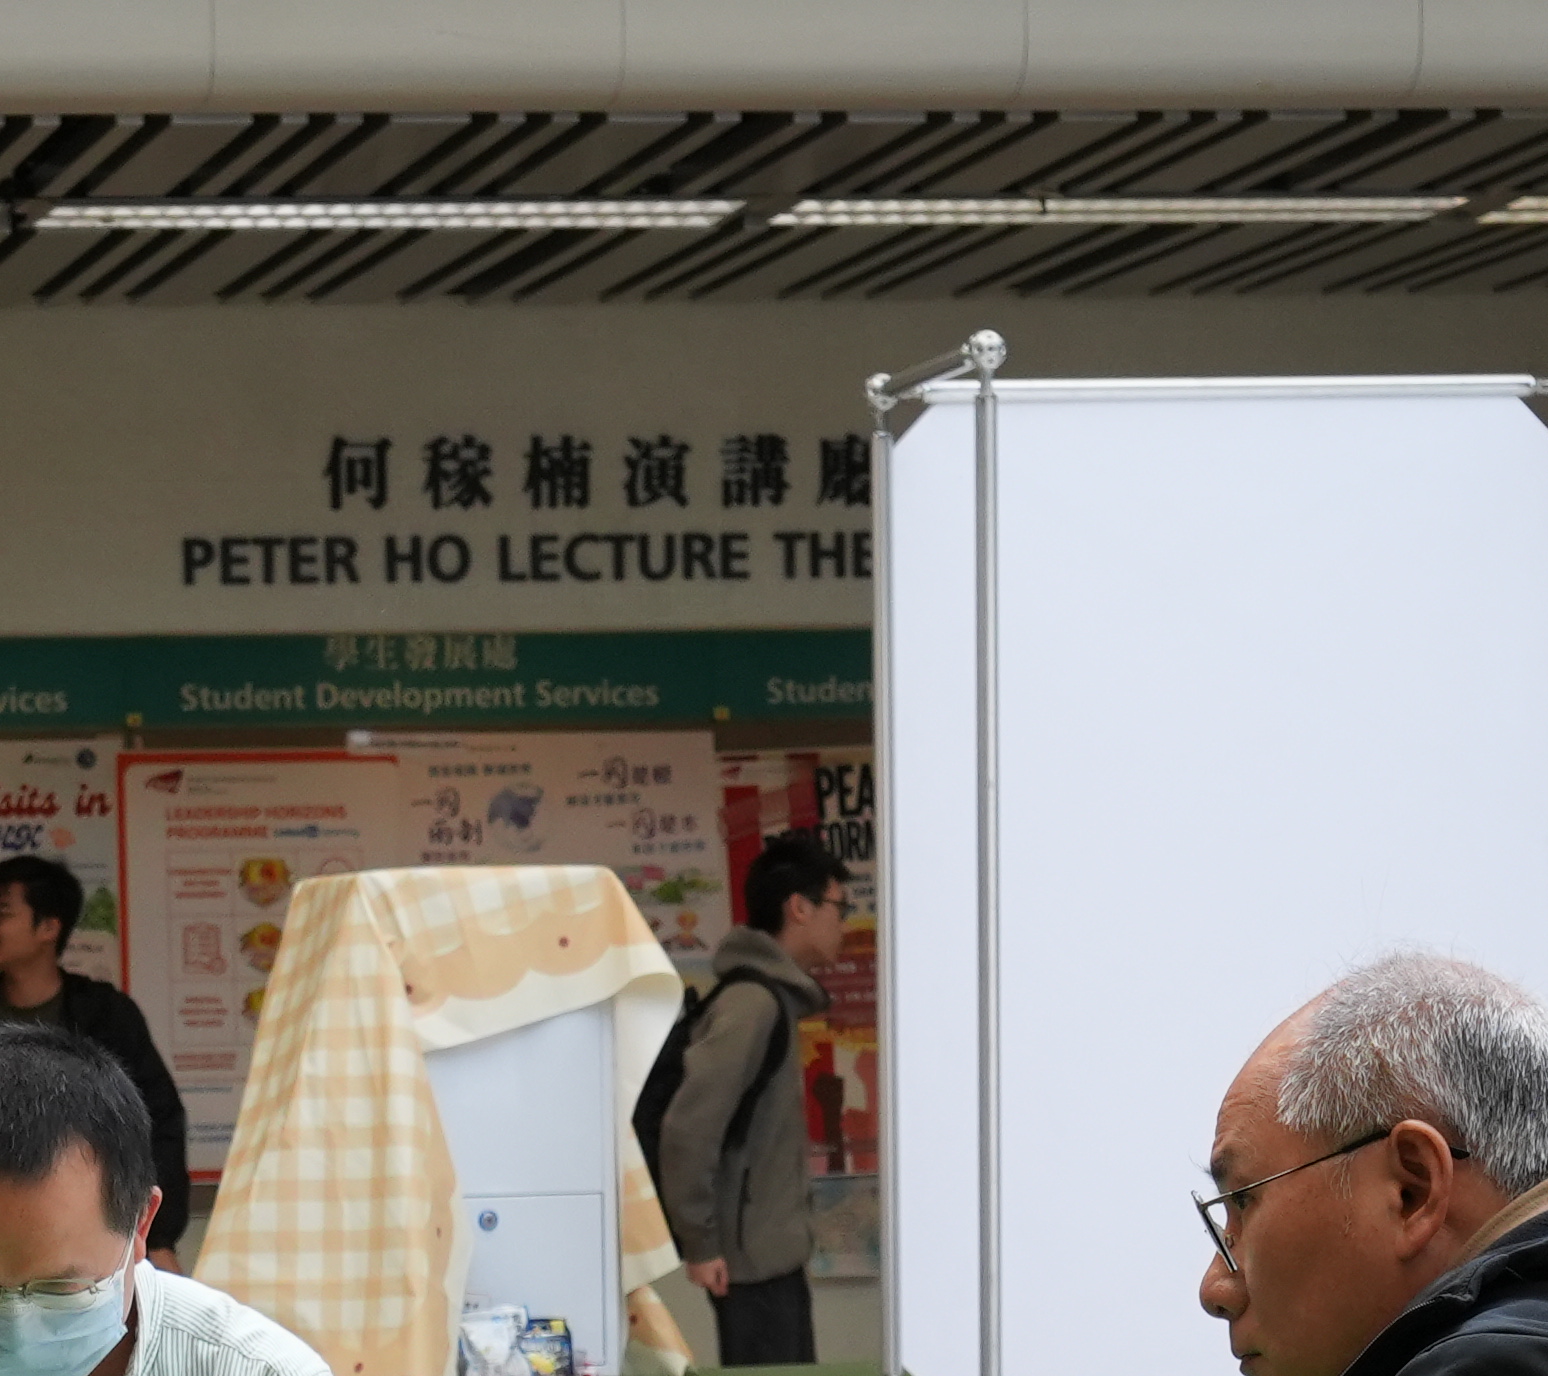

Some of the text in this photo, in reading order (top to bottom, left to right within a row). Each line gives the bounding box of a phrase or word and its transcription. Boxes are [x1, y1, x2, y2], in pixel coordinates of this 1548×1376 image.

[180, 535, 359, 587] PETER
[384, 532, 471, 584] HO
[497, 530, 751, 584] LECTURE
[179, 678, 661, 715] Student Development Services
[75, 783, 114, 817] in
